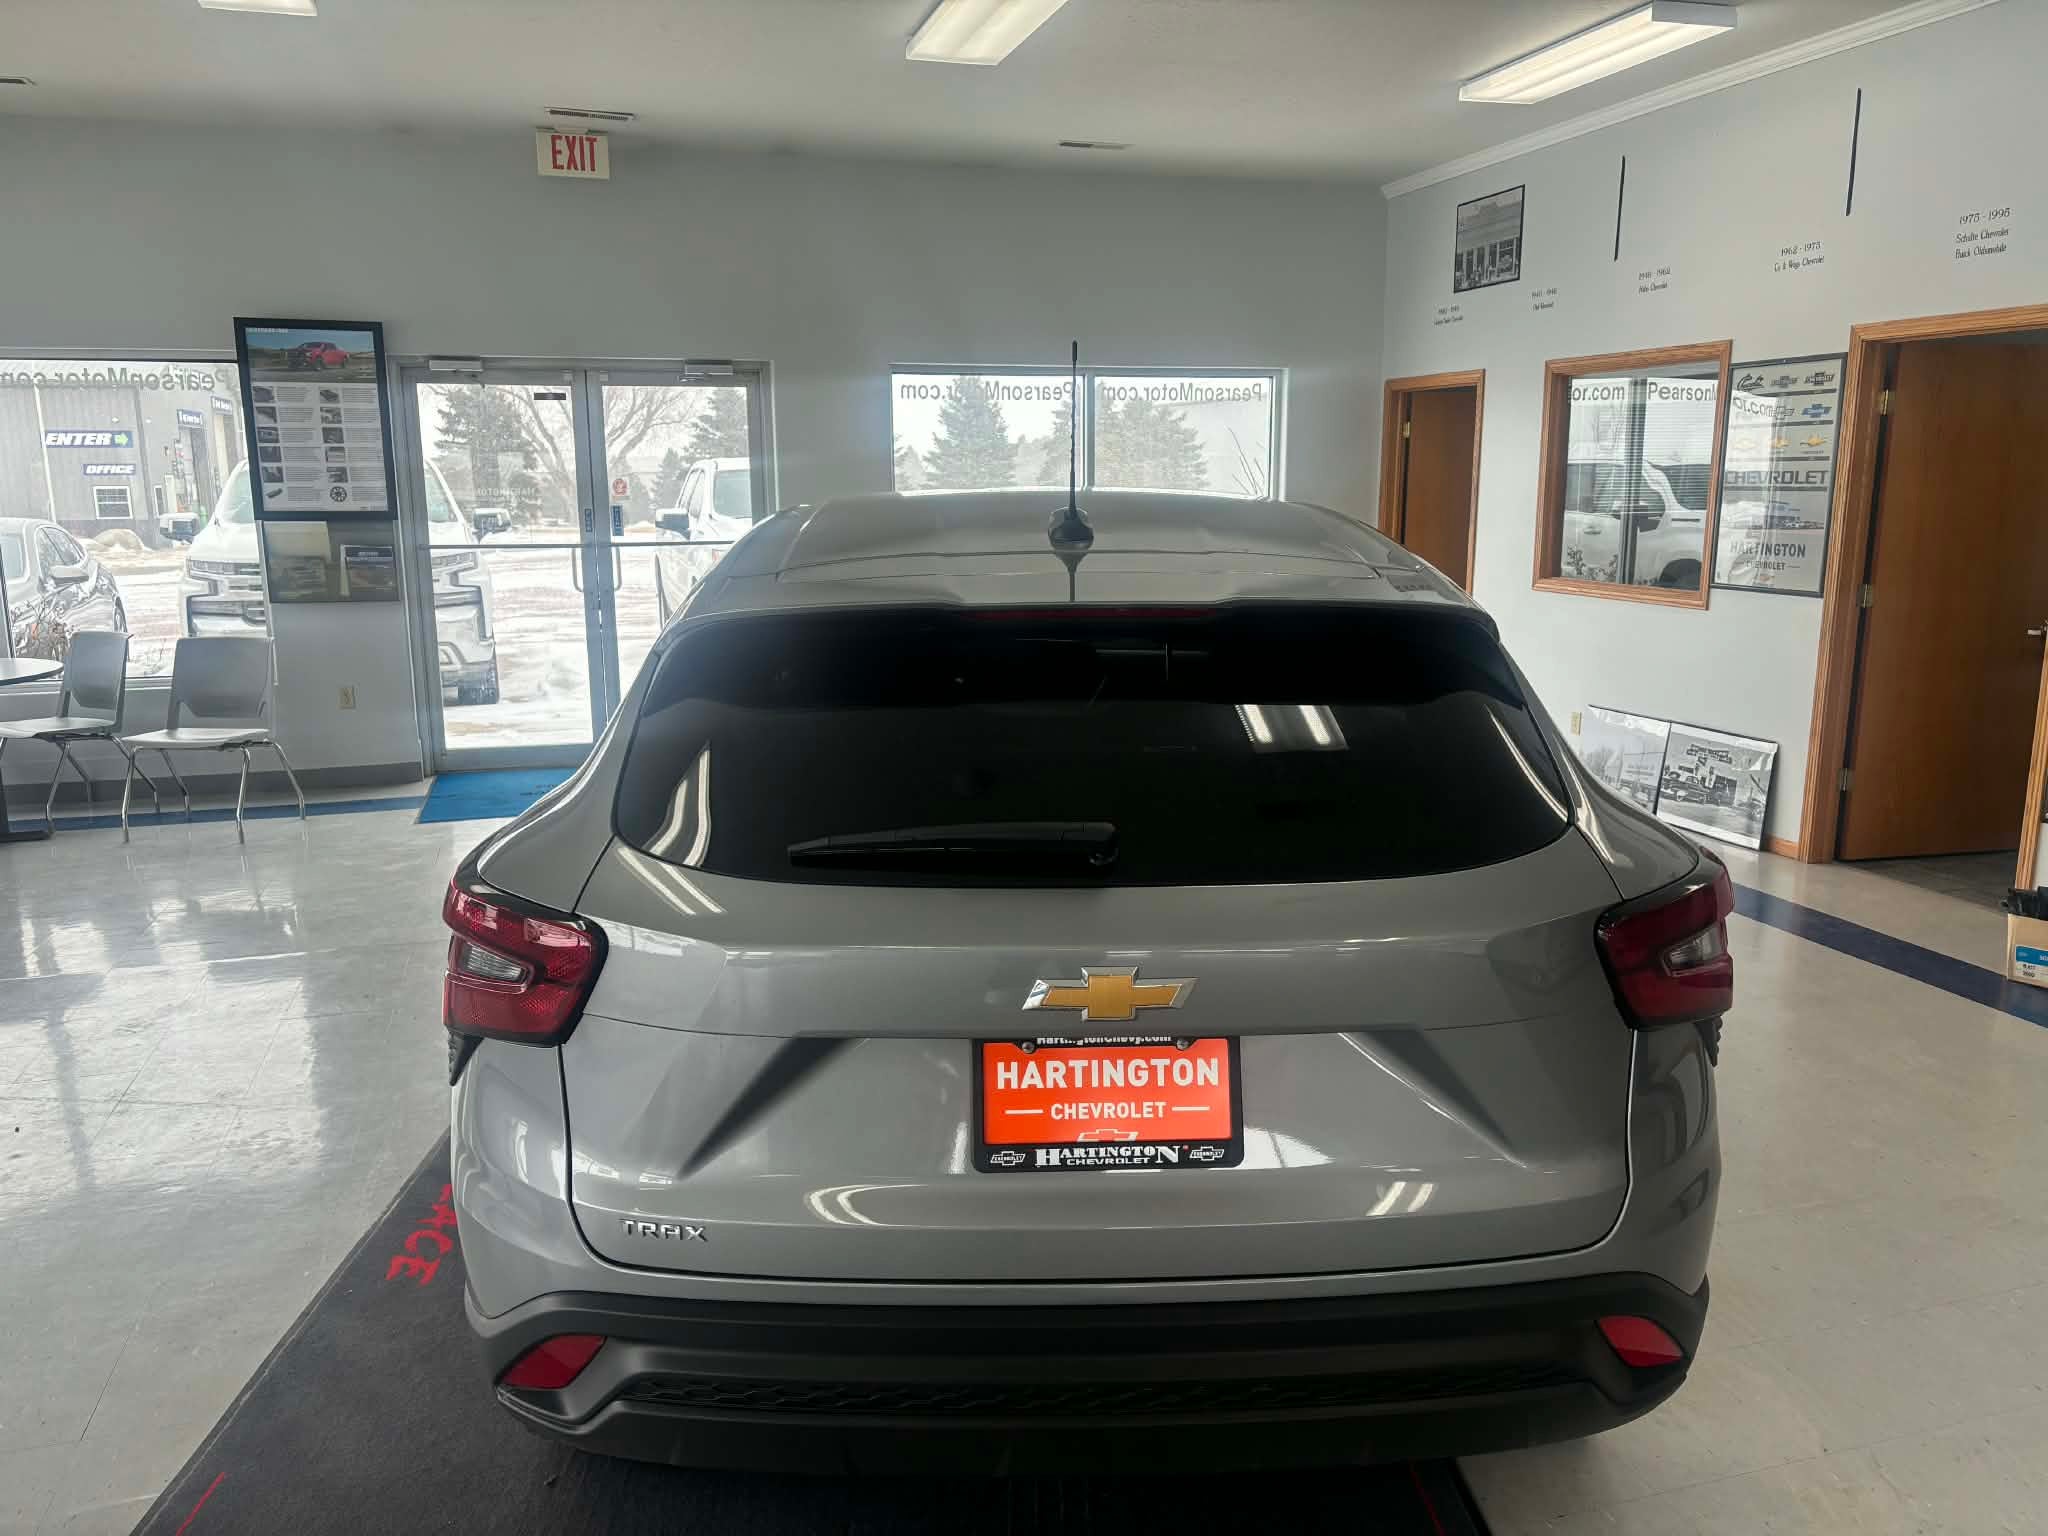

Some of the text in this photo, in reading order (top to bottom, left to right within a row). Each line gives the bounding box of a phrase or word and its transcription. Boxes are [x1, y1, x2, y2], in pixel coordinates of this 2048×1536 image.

[550, 134, 597, 171] EXIT
[1959, 212, 1981, 225] 1975
[1988, 207, 2011, 221] 1995
[1980, 228, 2009, 240] Chevrolet
[1647, 381, 1718, 401] Pearson
[45, 432, 112, 446] ENTER
[85, 465, 134, 475] OFFICE
[1724, 470, 1829, 485] CHEVROLET
[996, 1057, 1220, 1090] HARTINGTON
[1050, 1101, 1167, 1121] CHEVROLET
[1034, 1145, 1181, 1168] HARTINGTON
[1065, 1157, 1151, 1166] CHEVROLET
[620, 1219, 709, 1242] TRAX
